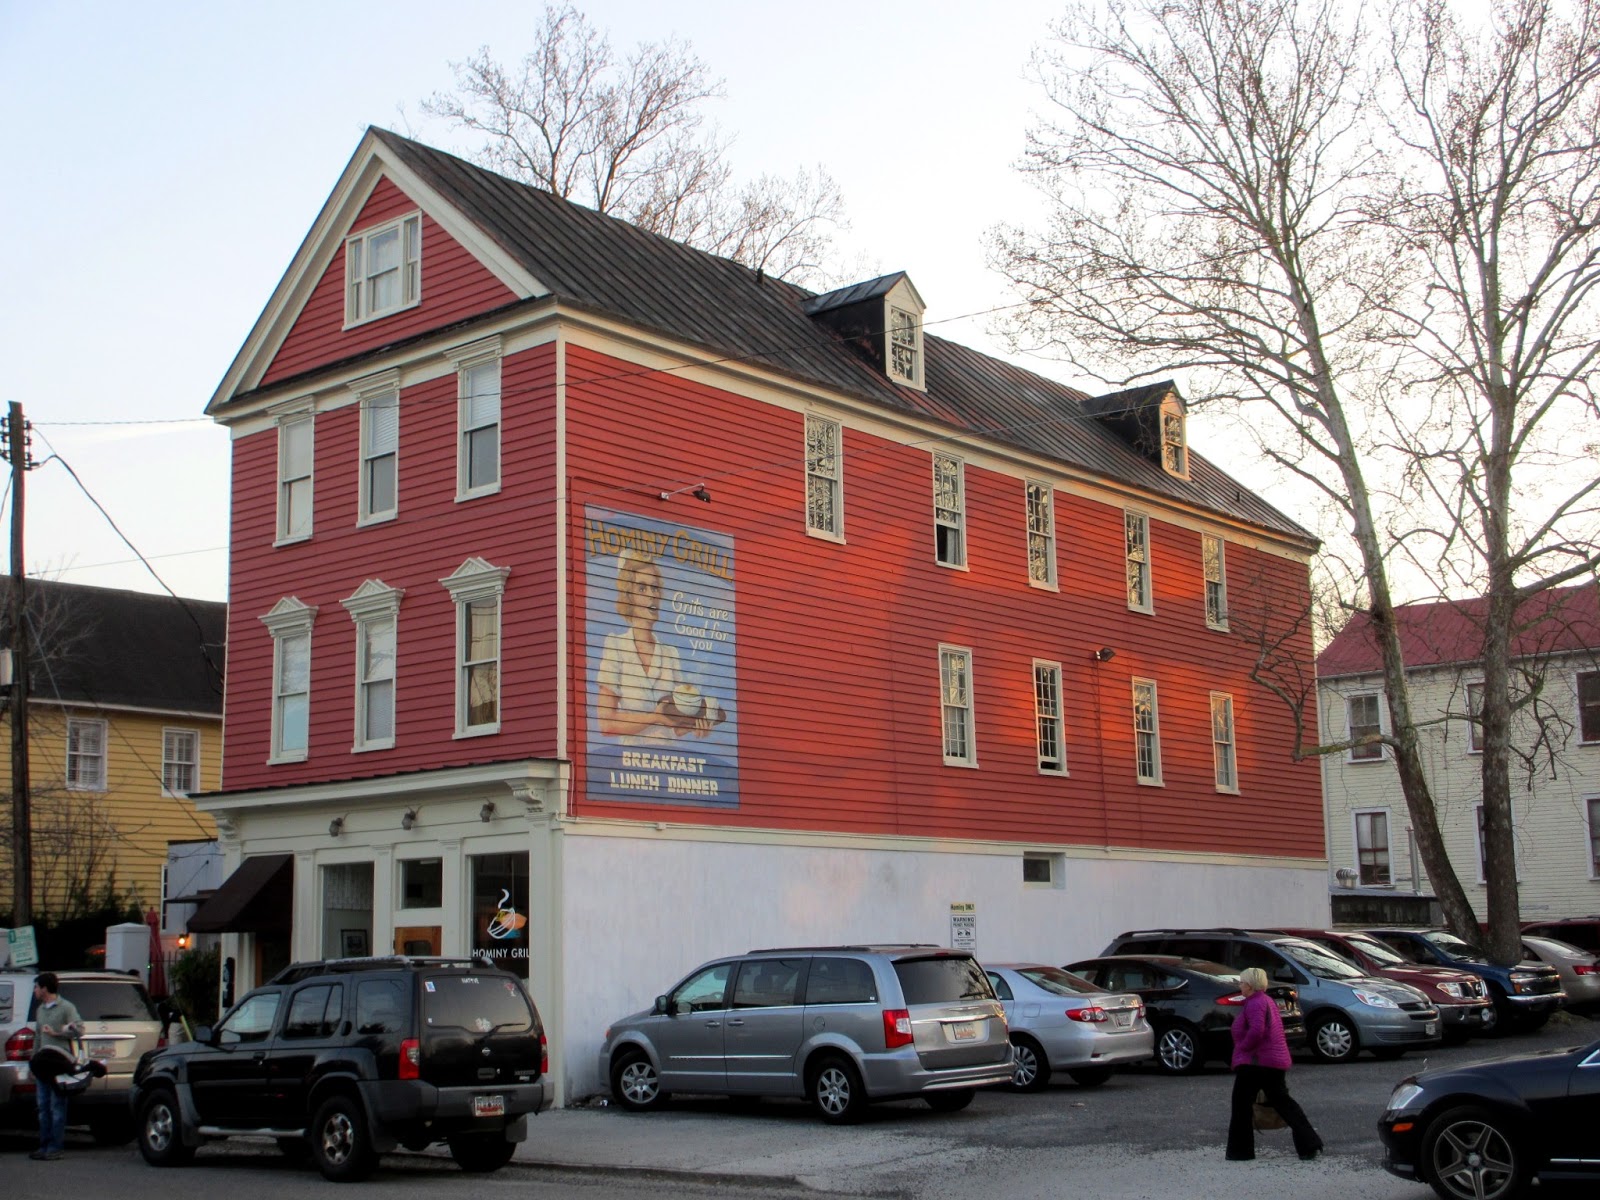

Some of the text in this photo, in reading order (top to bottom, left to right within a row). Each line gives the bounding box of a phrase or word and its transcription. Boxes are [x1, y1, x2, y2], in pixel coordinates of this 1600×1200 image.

[672, 529, 734, 583] GRILL
[672, 591, 729, 621] Grits are
[674, 613, 729, 641] Good for
[689, 639, 714, 657] you
[622, 751, 707, 773] BREAKFAST
[610, 771, 719, 796] LUNCH DINNER
[472, 948, 530, 959] HOMINY GRIL
